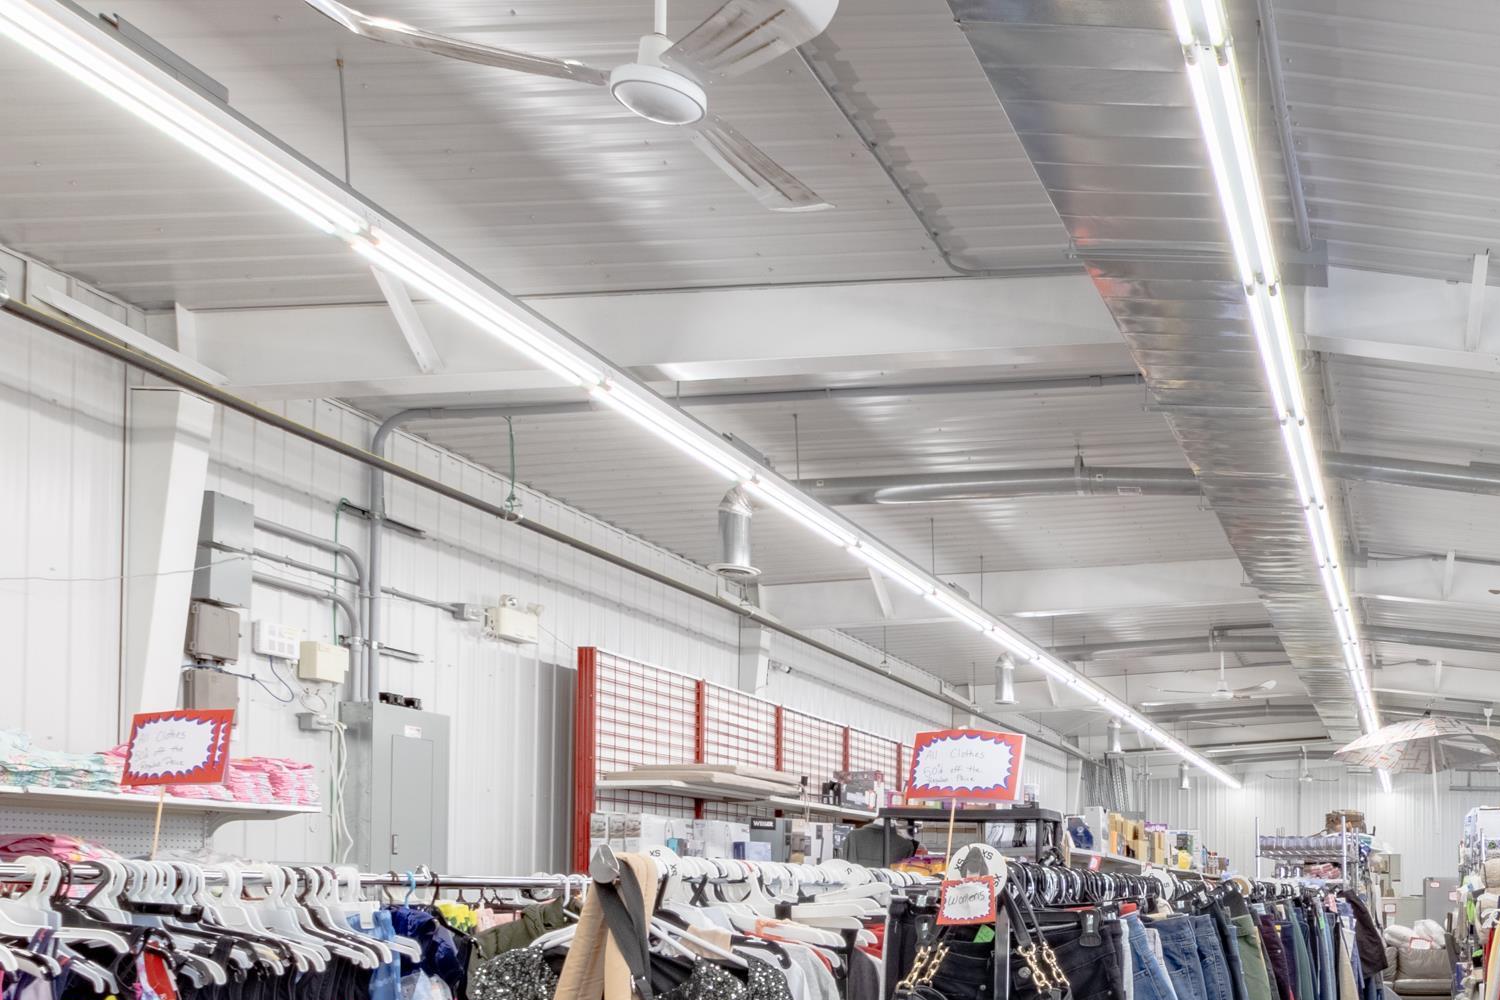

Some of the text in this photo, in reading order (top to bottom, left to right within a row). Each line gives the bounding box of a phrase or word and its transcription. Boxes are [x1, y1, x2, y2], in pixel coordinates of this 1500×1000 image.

[650, 849, 661, 857] XS
[982, 849, 994, 860] XS
[954, 858, 964, 871] XS
